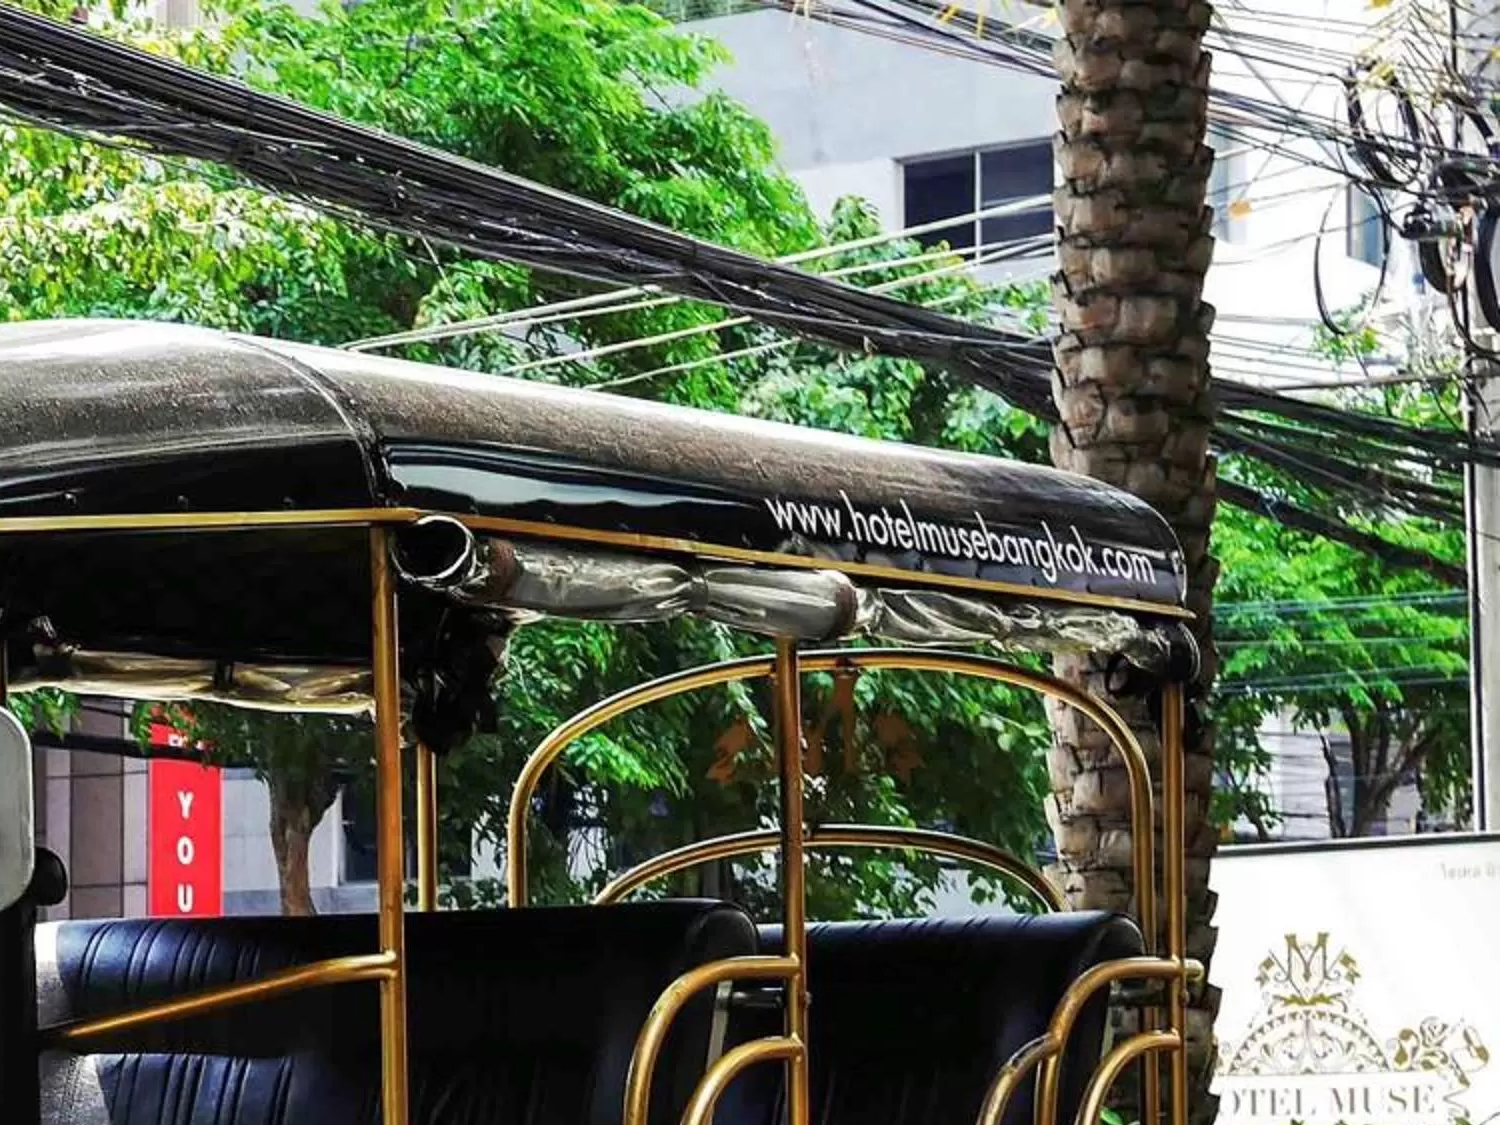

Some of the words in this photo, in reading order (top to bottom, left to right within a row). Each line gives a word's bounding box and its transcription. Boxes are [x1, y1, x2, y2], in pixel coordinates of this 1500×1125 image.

[764, 490, 1157, 584] www.hotelmusebangkok.com
[177, 791, 194, 913] YOU
[1220, 1088, 1316, 1117] OTEL
[1330, 1086, 1436, 1116] MUSE
